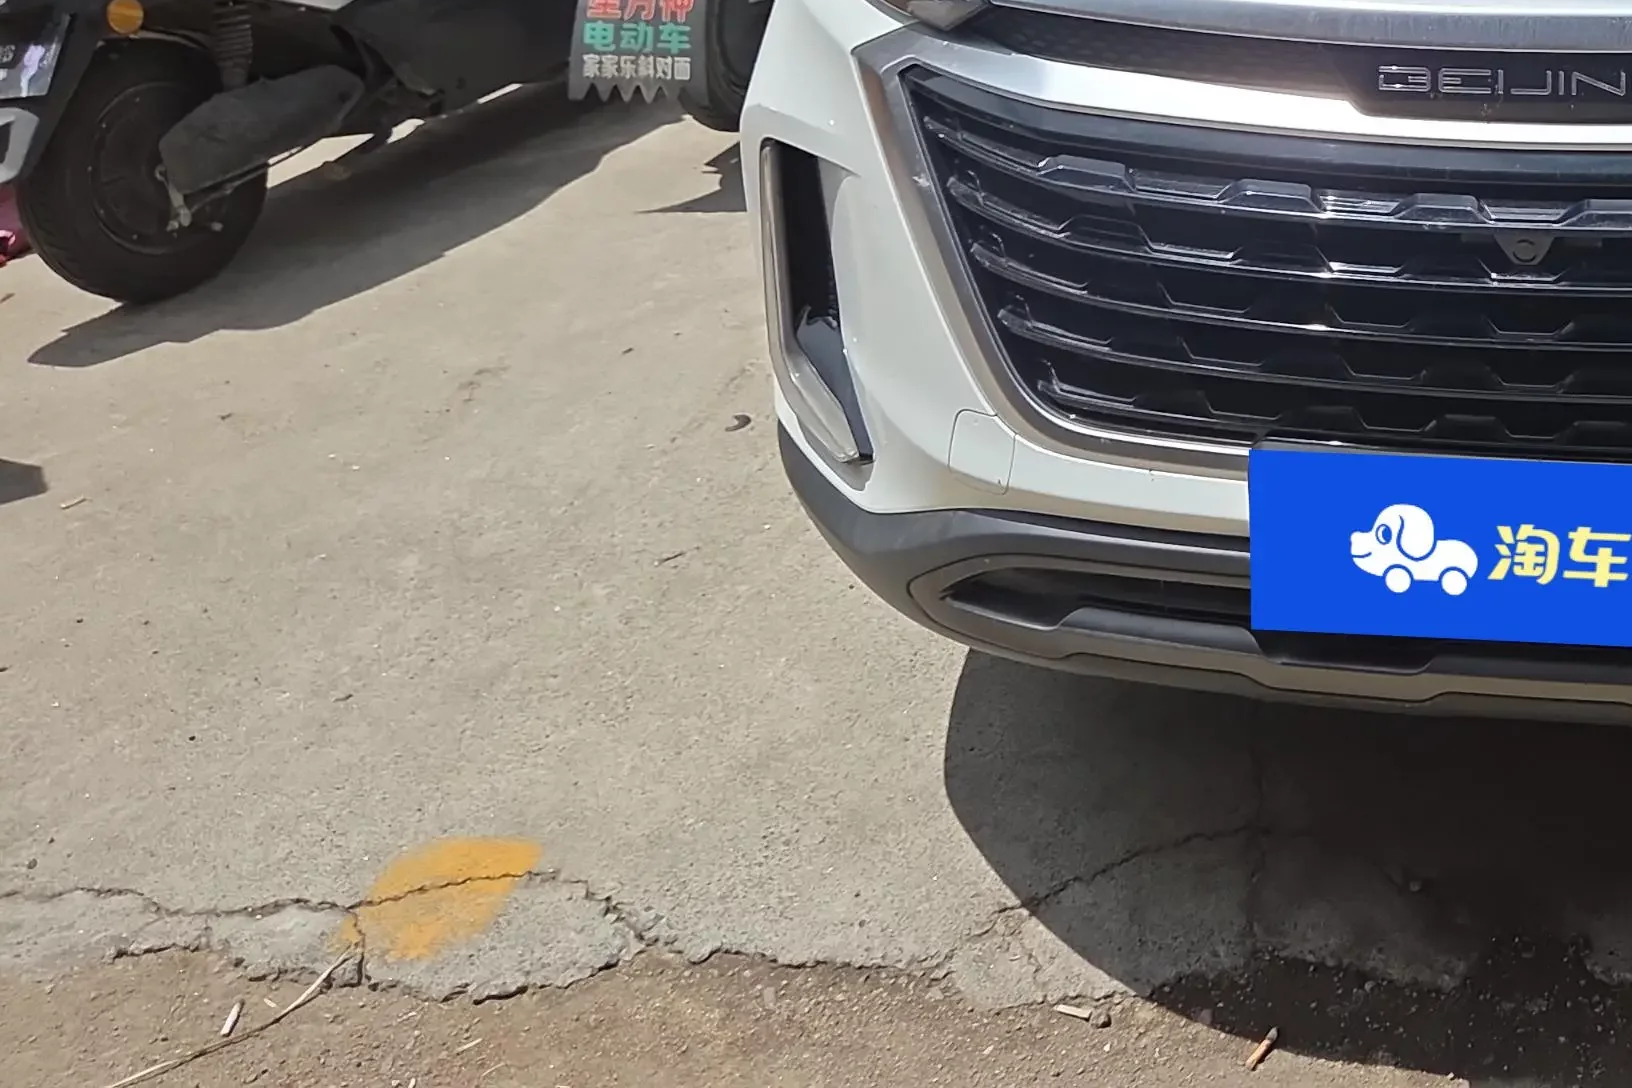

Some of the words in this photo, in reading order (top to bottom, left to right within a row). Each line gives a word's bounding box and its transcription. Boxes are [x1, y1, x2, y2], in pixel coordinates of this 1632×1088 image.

[583, 20, 692, 54] 电动车
[582, 53, 692, 80] 家家乐斜对面
